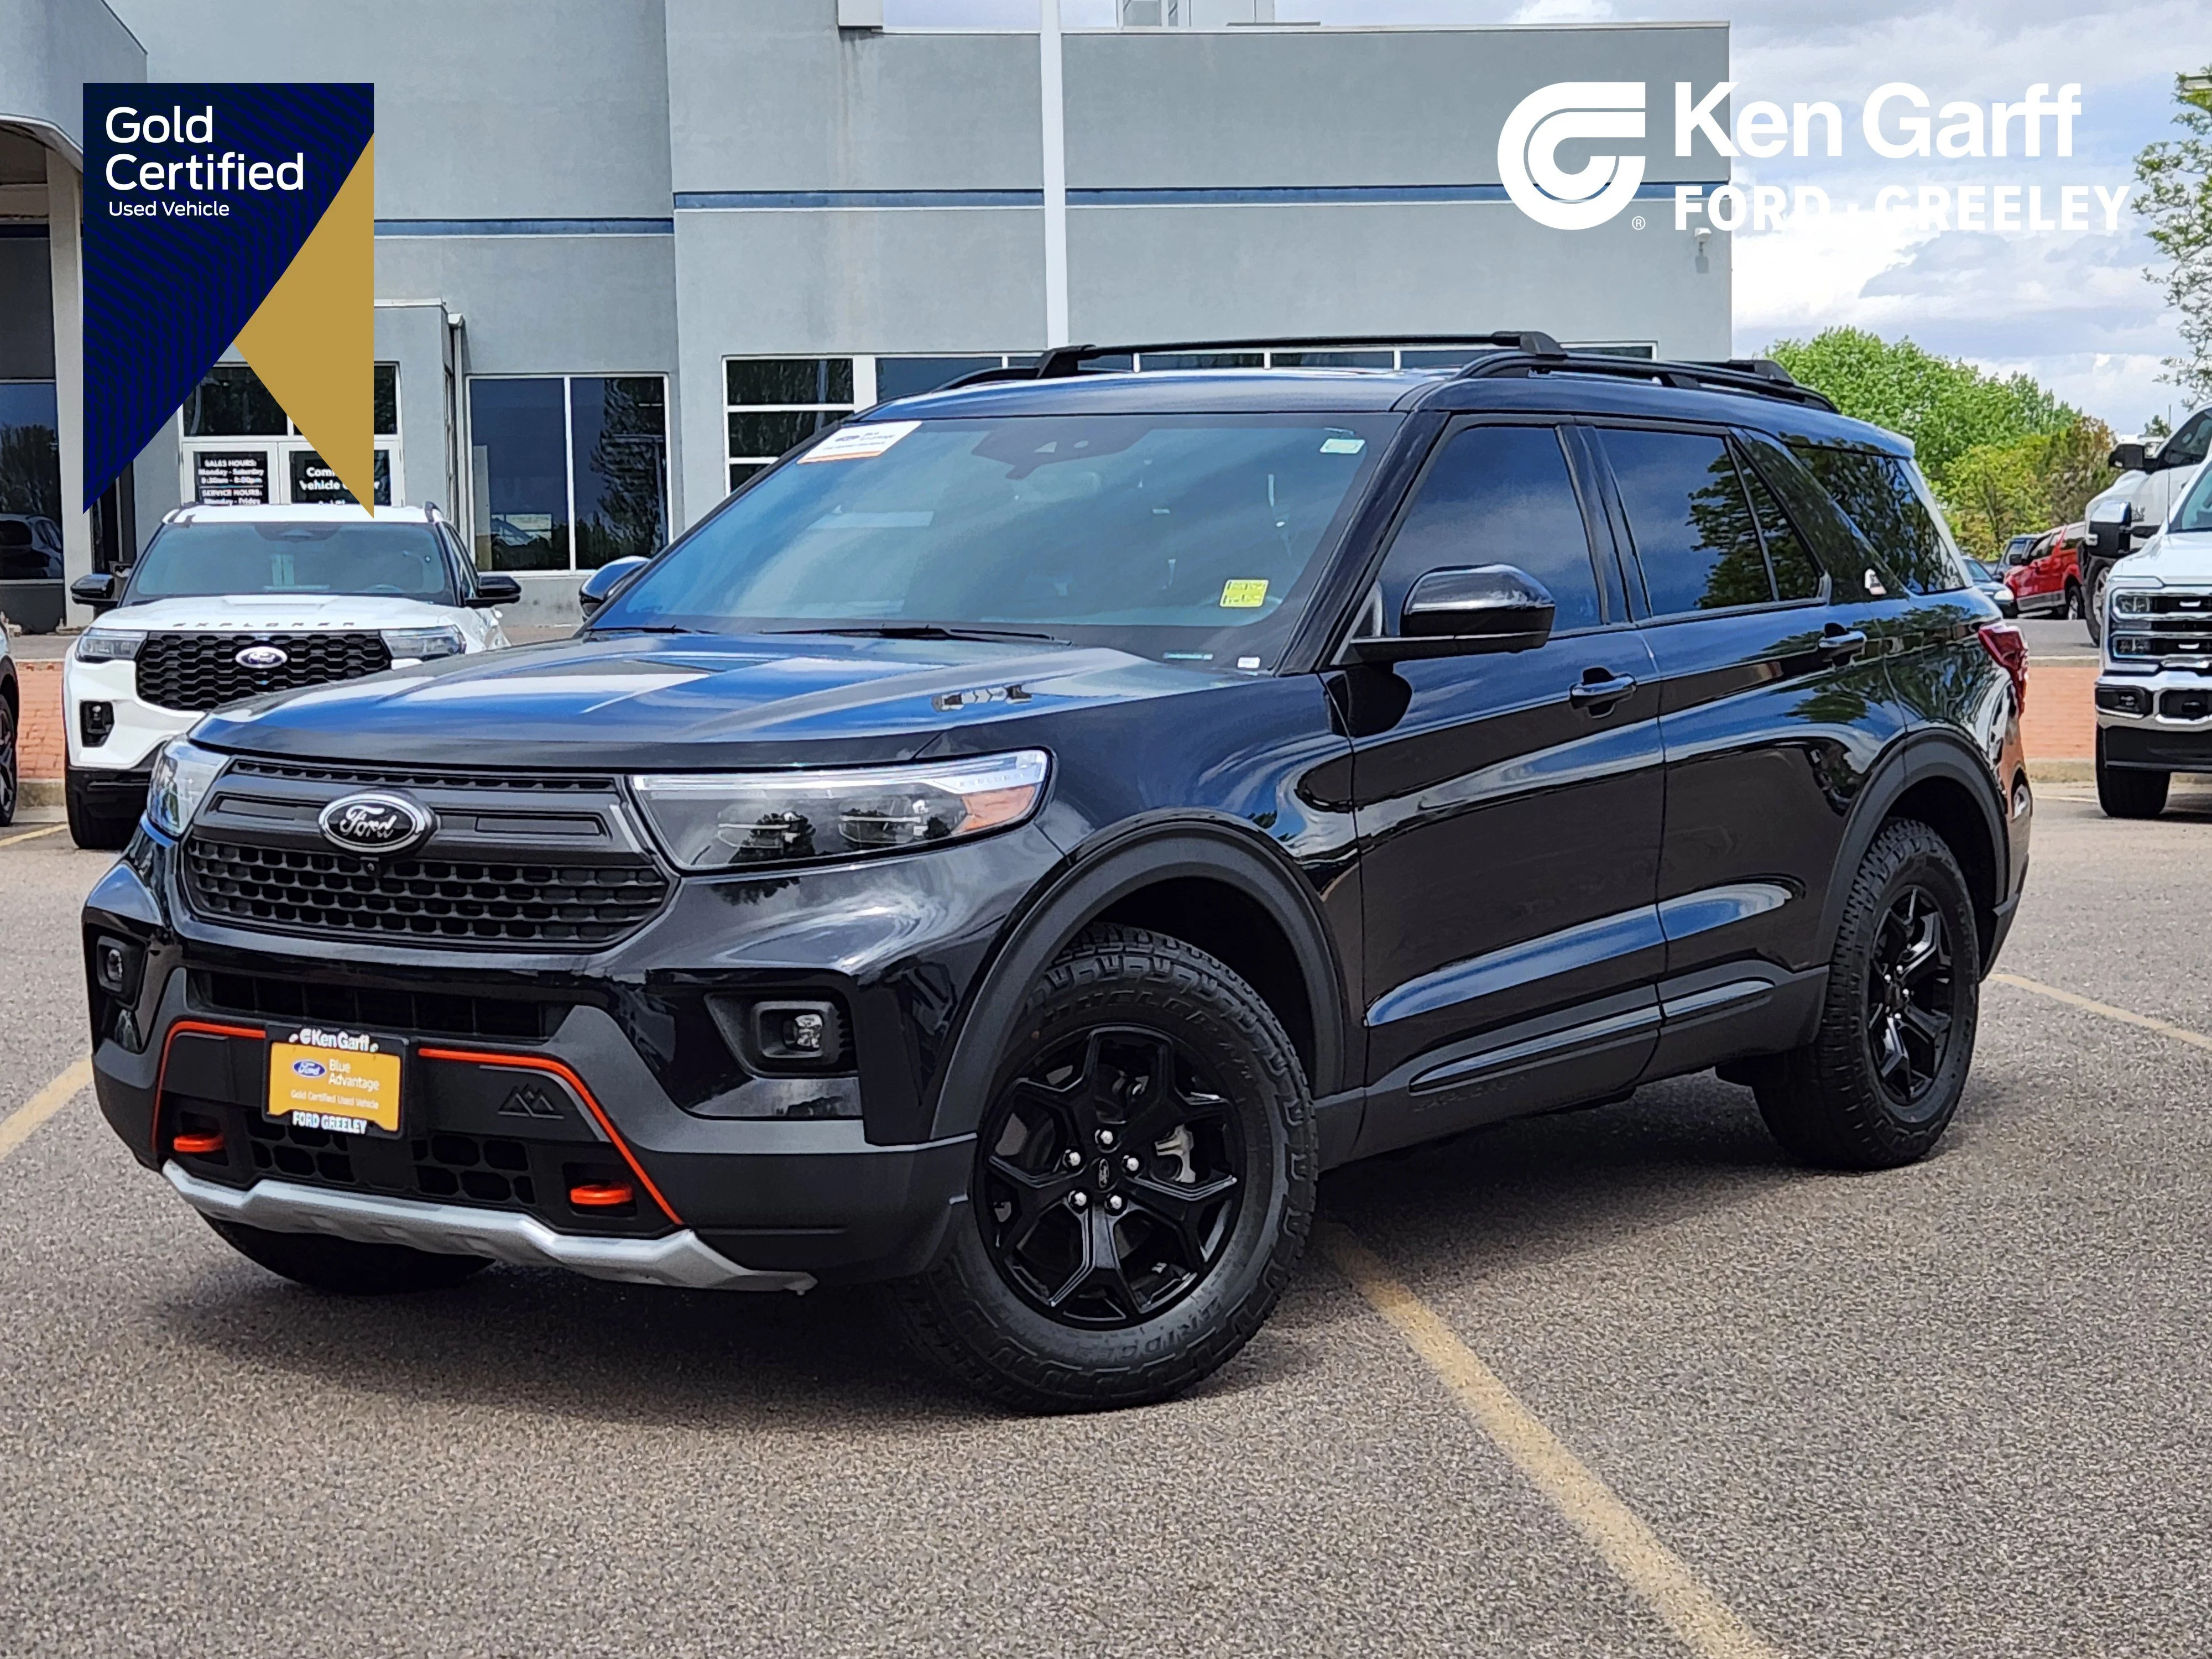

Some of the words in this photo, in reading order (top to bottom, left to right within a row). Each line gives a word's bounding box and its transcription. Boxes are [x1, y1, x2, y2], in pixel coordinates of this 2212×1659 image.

[299, 479, 341, 490] Vehicle
[340, 805, 398, 838] Ford
[311, 1029, 337, 1048] Ken
[329, 1058, 351, 1073] Blue
[328, 1073, 380, 1092] Advantage
[293, 1110, 320, 1129] FORD
[321, 1114, 368, 1134] GREELEY
